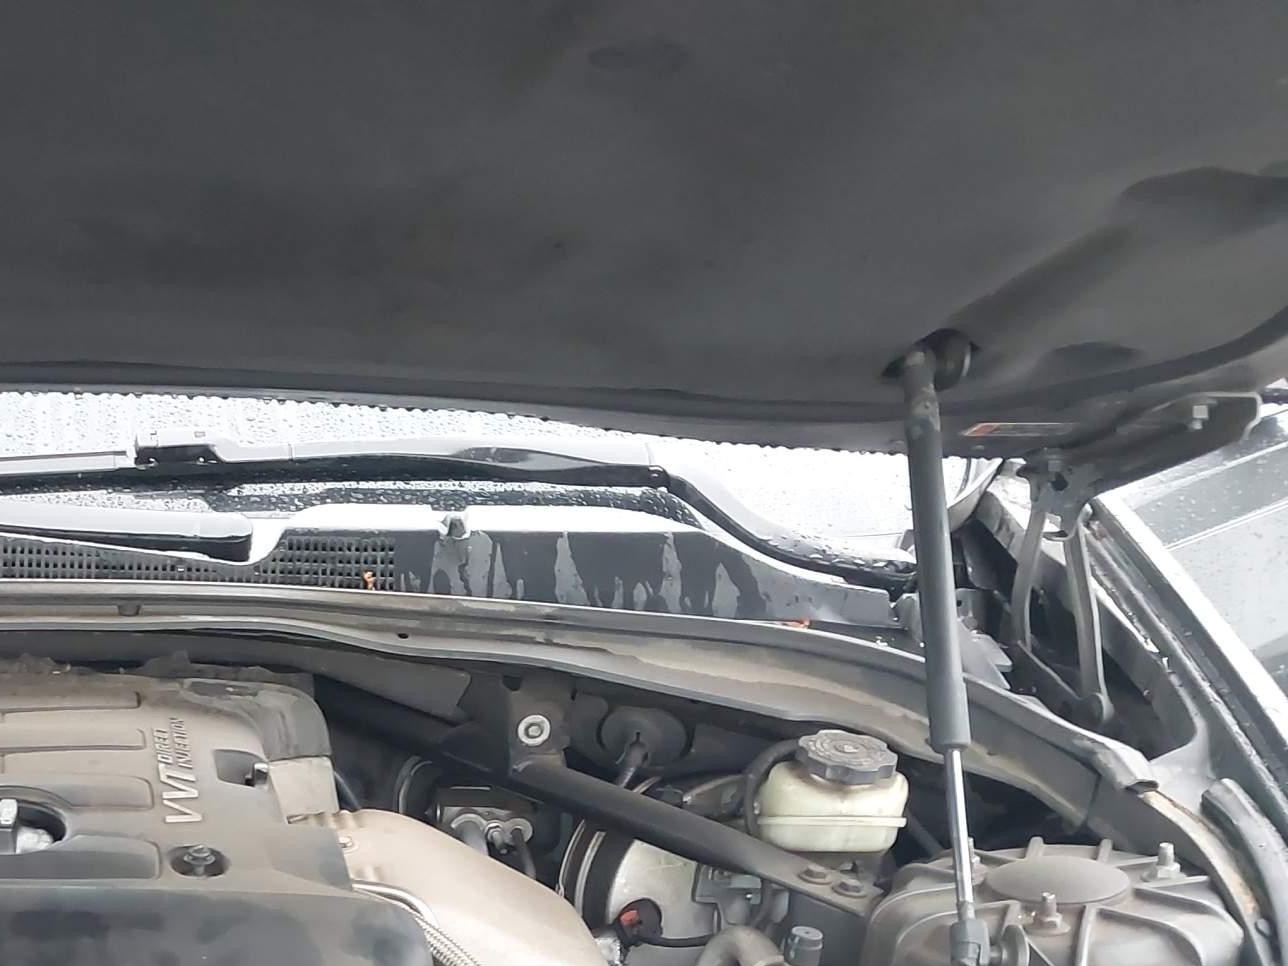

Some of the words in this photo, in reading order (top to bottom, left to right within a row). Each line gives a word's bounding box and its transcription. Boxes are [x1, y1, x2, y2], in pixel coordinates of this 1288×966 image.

[152, 728, 173, 765] DIRECT
[169, 716, 193, 769] INJECTION
[158, 762, 202, 823] VVT
